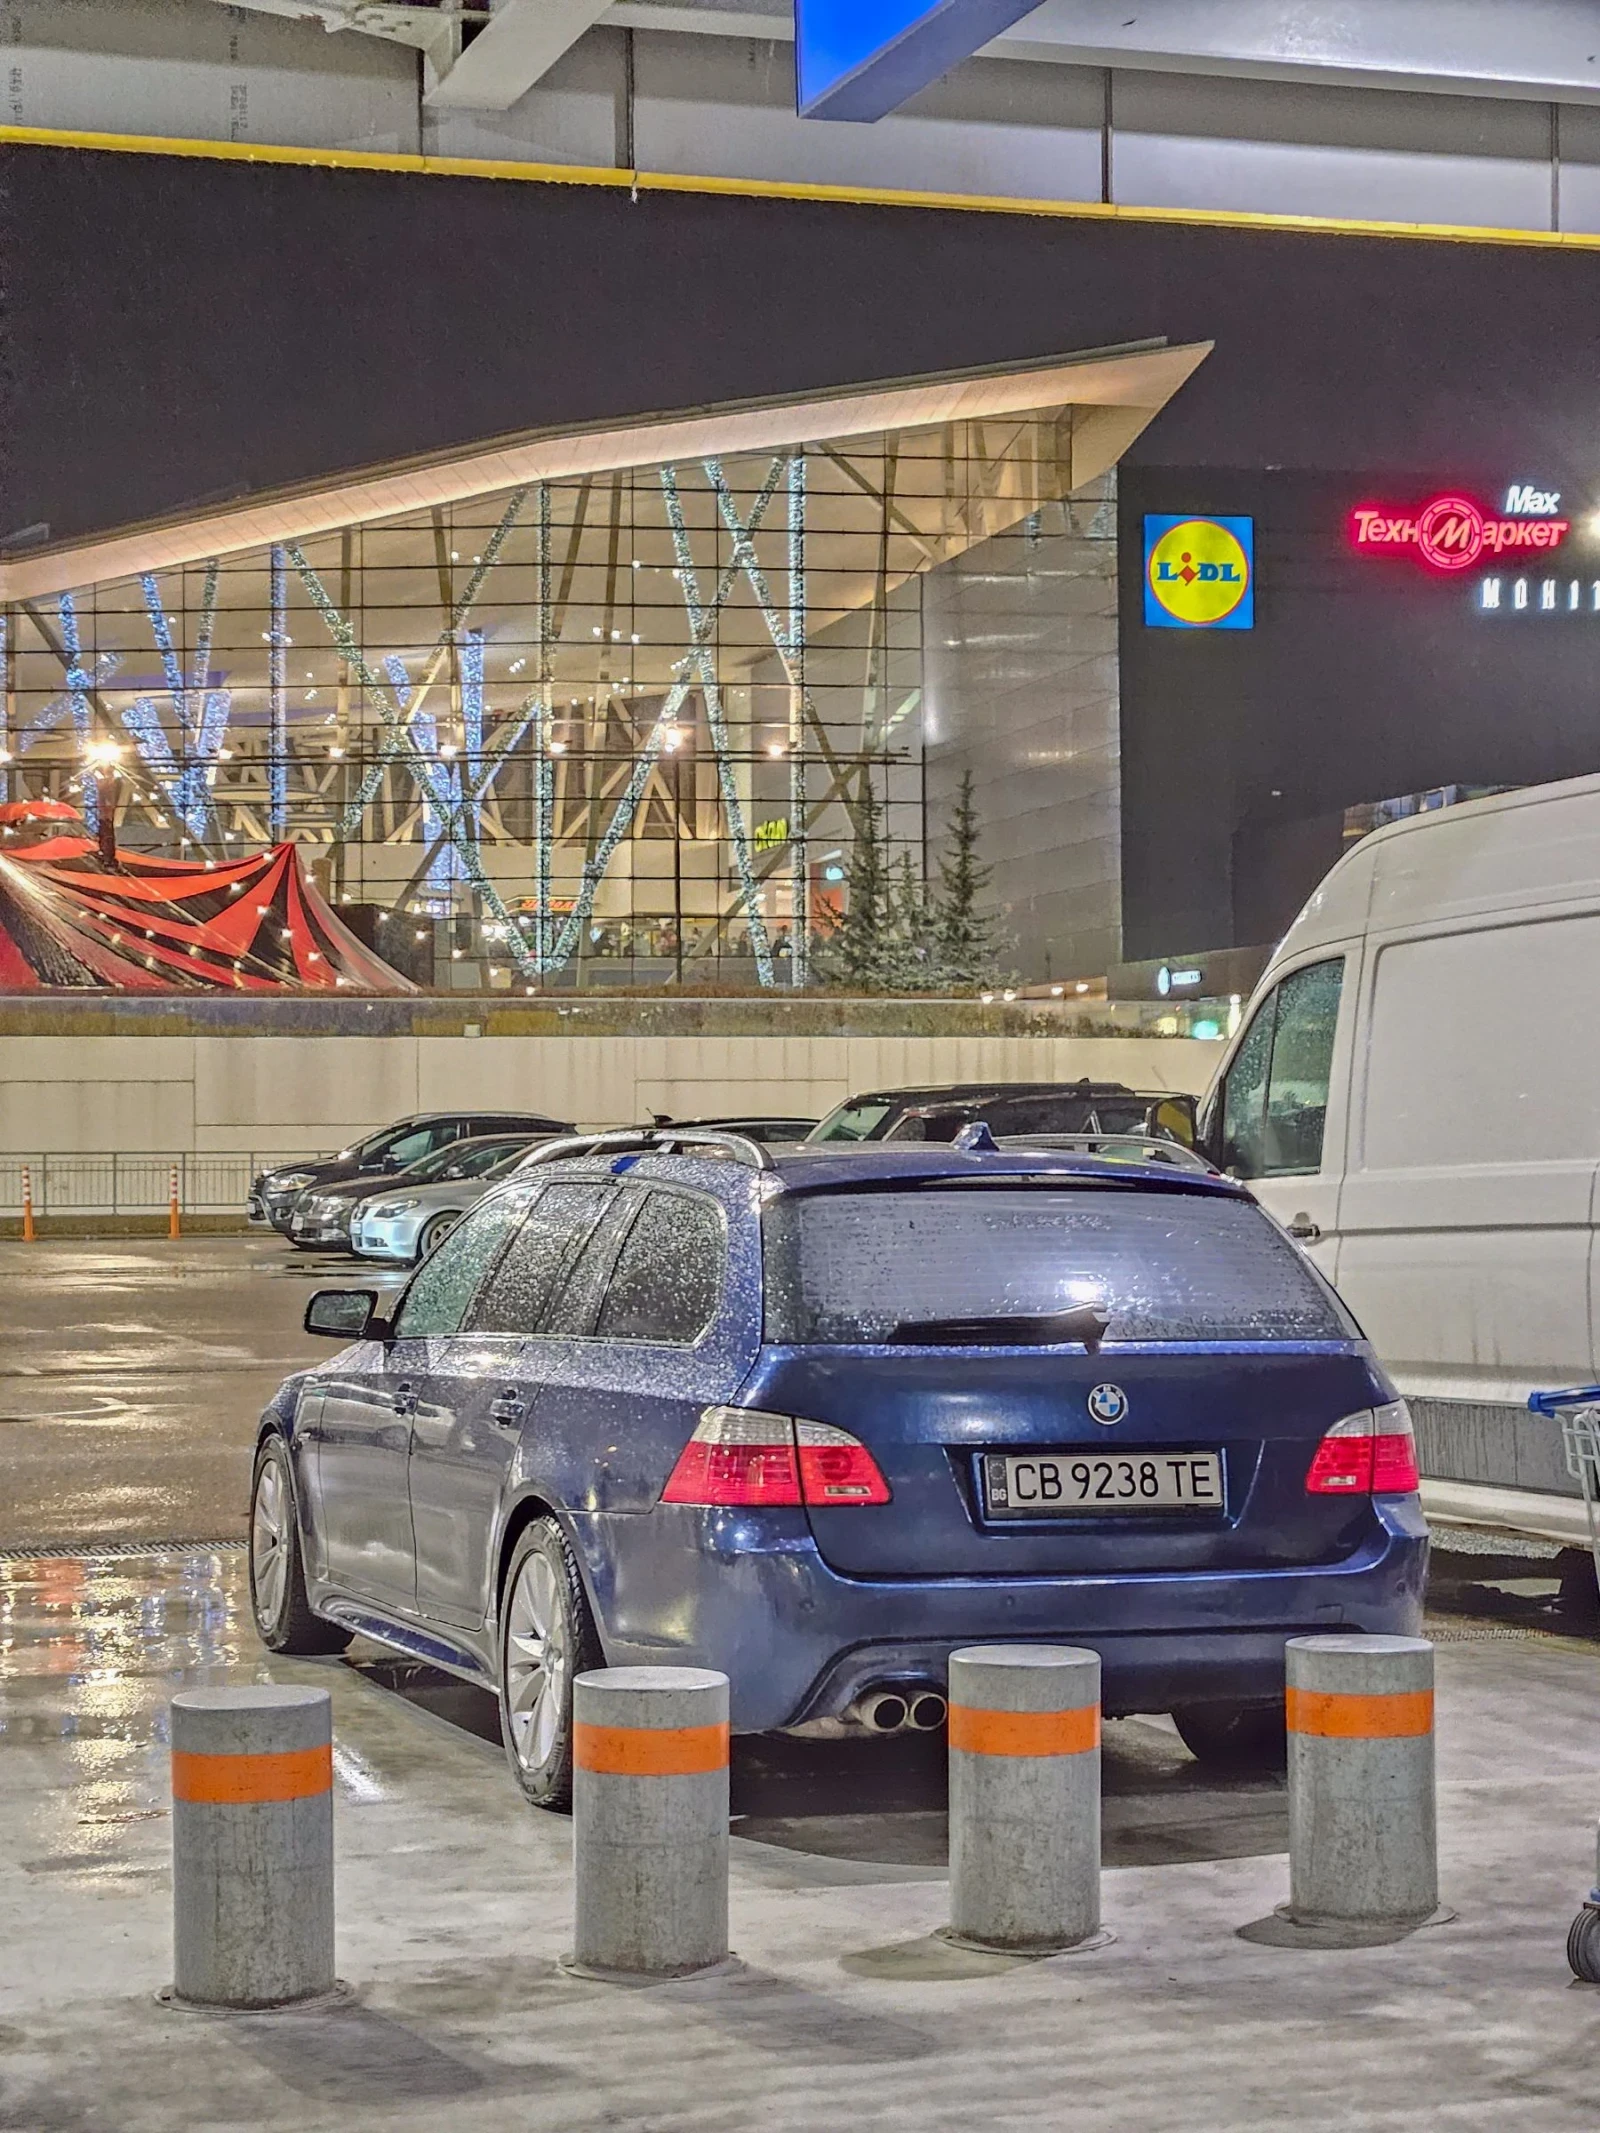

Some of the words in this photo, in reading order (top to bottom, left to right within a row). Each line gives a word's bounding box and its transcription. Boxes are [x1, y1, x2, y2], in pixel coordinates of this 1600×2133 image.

[1505, 484, 1561, 515] Max
[991, 1488, 1007, 1501] BG
[1014, 1463, 1063, 1501] CB
[1071, 1461, 1159, 1499] 9238
[1166, 1460, 1214, 1498] TE
